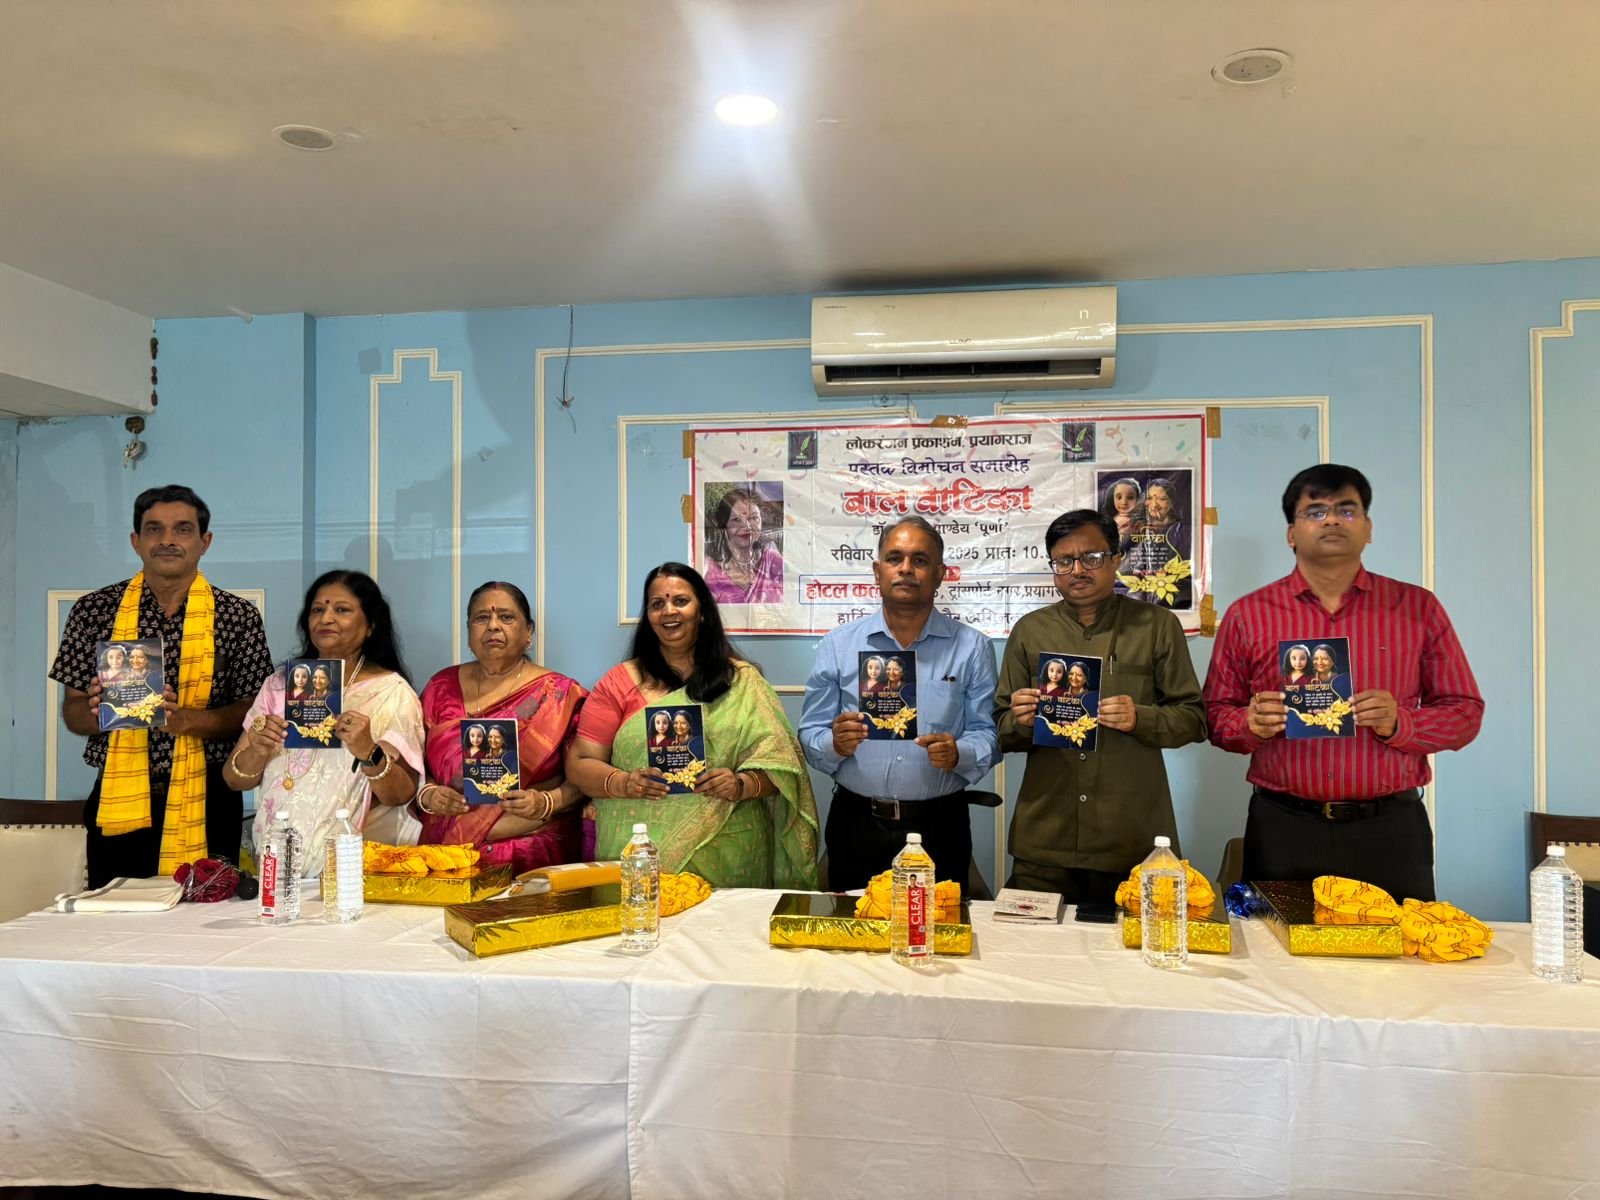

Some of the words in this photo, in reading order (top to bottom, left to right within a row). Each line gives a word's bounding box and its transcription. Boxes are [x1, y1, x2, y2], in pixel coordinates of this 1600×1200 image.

[969, 433, 1032, 448] प्रयागराज
[902, 457, 965, 474] विमोचन
[970, 454, 1030, 475] समारोह
[842, 488, 909, 516] बाल
[914, 477, 1034, 514] वाटिका
[830, 544, 874, 561] रविवार
[947, 546, 979, 560] 2025
[984, 546, 1016, 560] प्रातः
[806, 579, 848, 600] होटल
[264, 857, 274, 890] CLEAR
[910, 889, 920, 925] CLEAR
